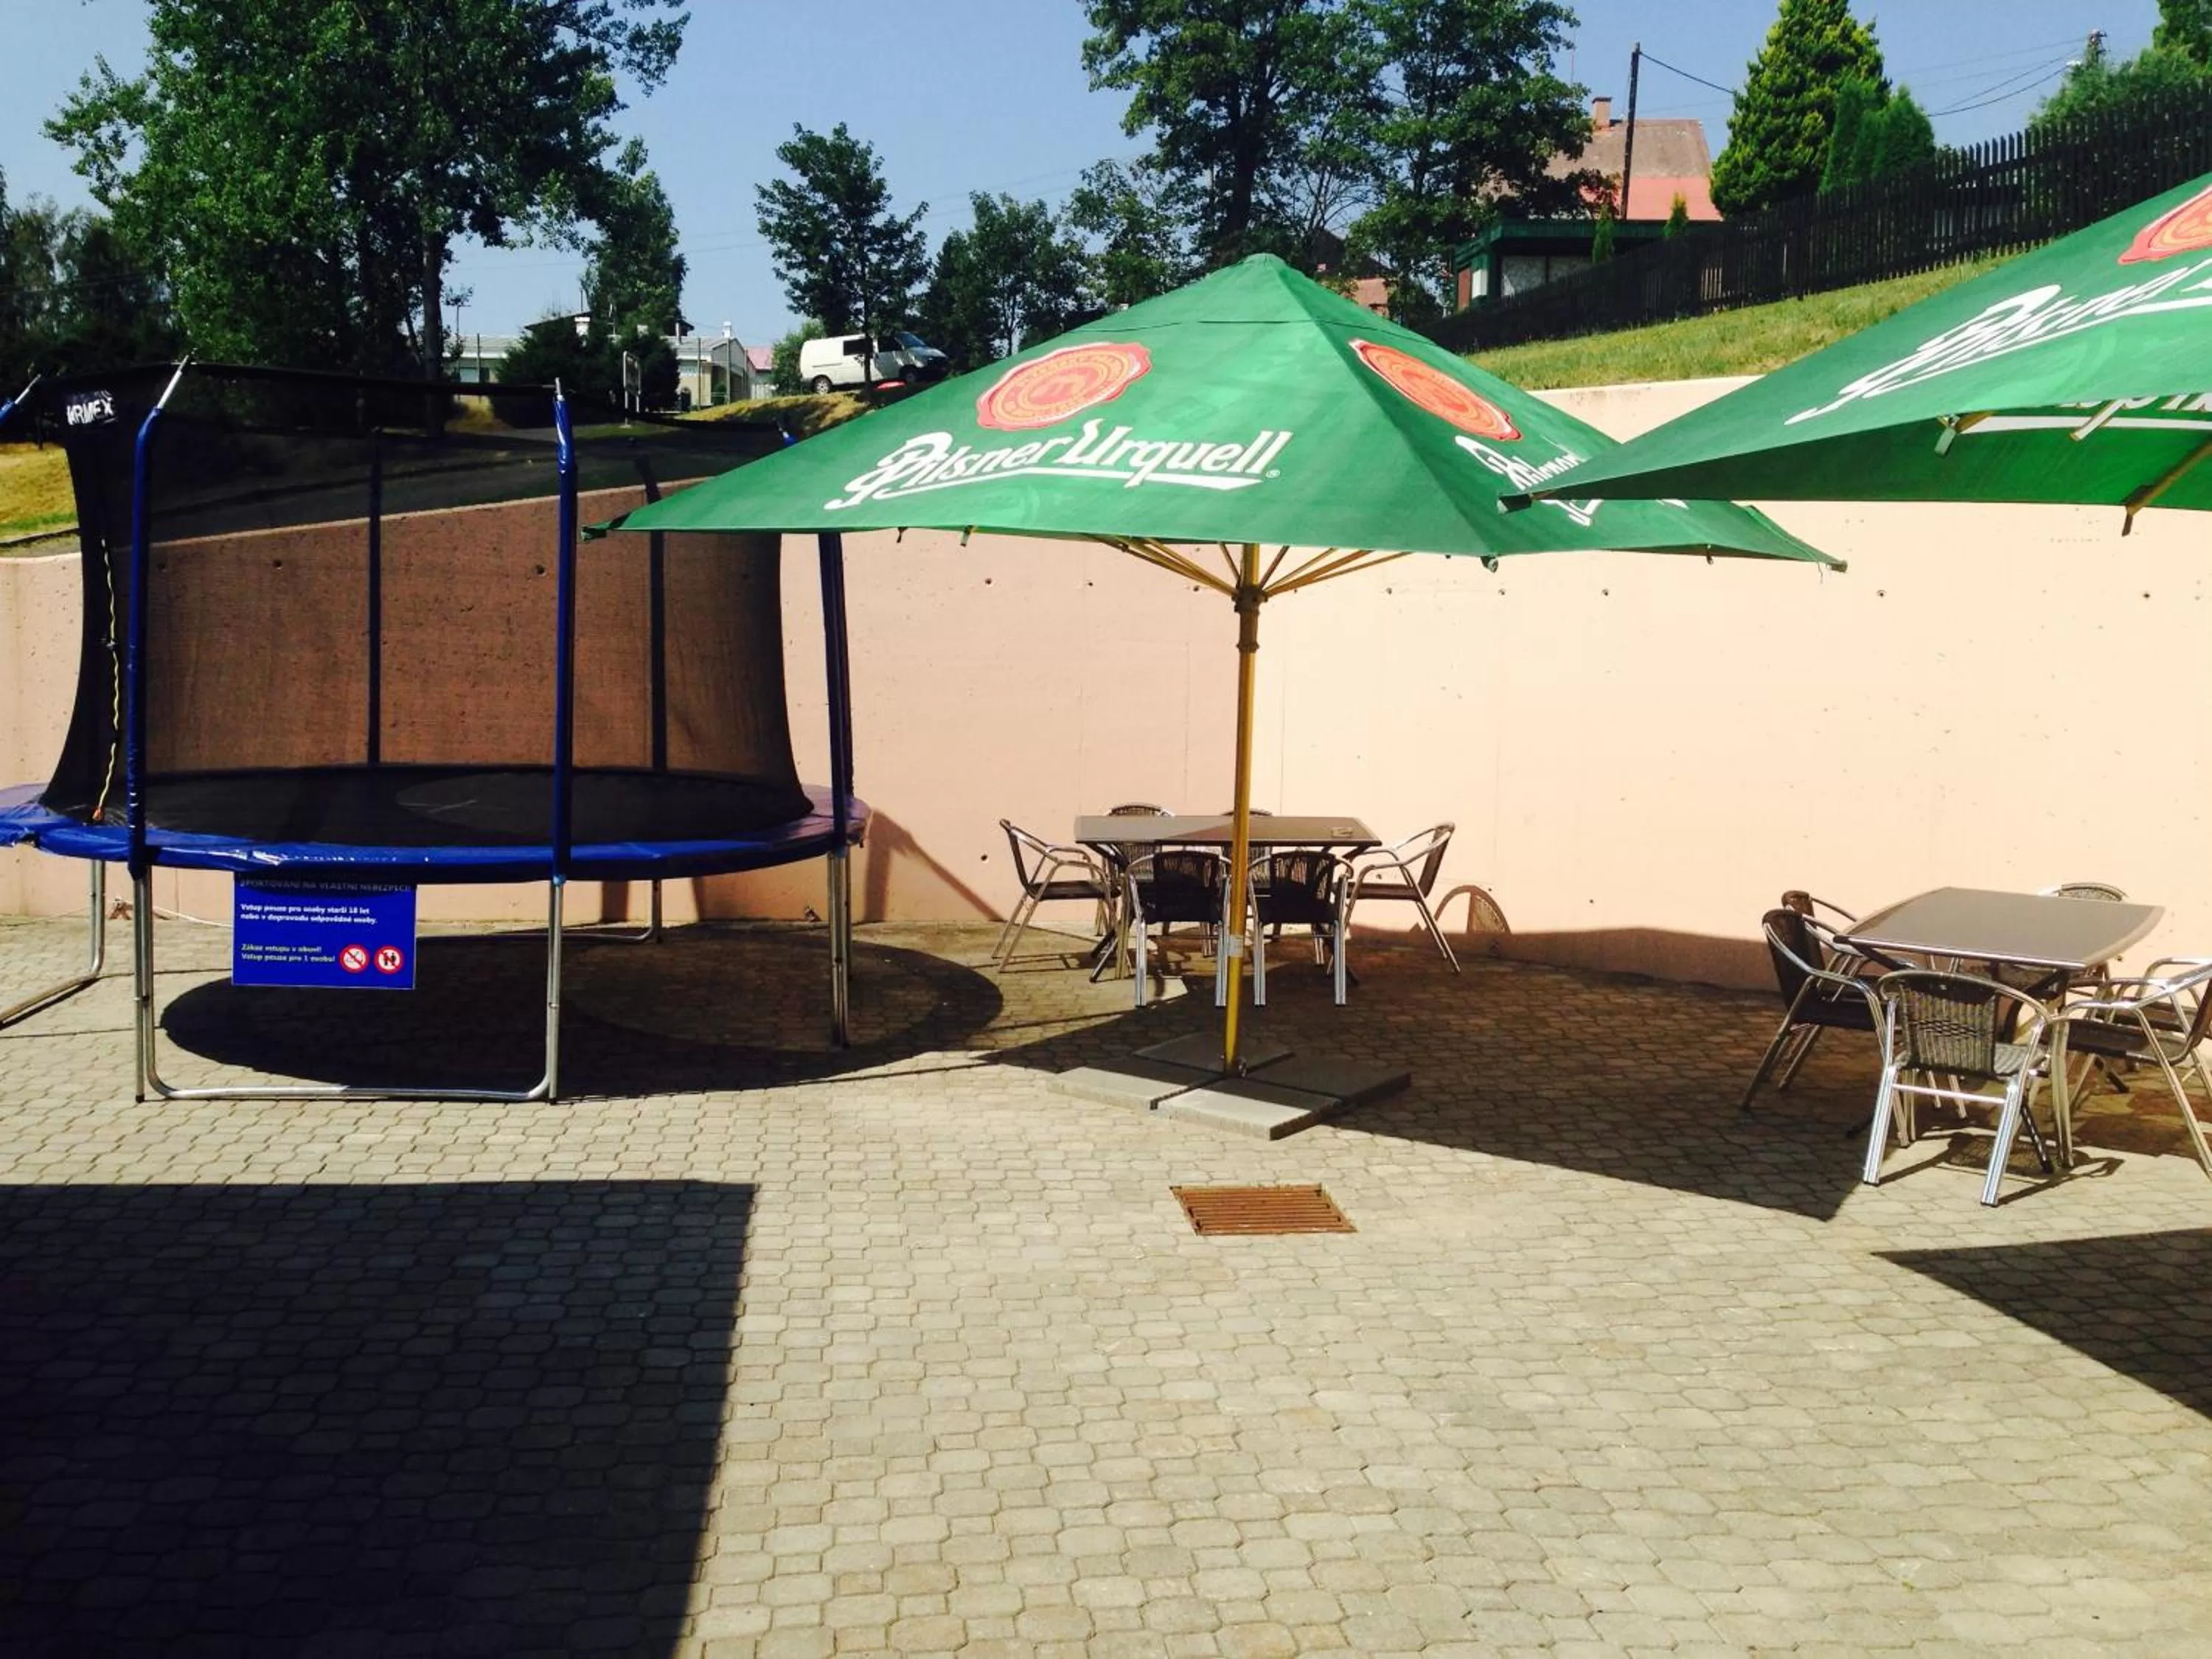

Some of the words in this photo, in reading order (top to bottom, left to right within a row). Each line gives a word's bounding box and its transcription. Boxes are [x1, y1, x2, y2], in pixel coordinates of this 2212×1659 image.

[824, 431, 1074, 509] Pilsner
[1051, 418, 1293, 488] Urquell
[240, 903, 262, 911] Vstup
[359, 906, 369, 914] let
[240, 912, 260, 920] nebo
[241, 953, 262, 961] Vstup
